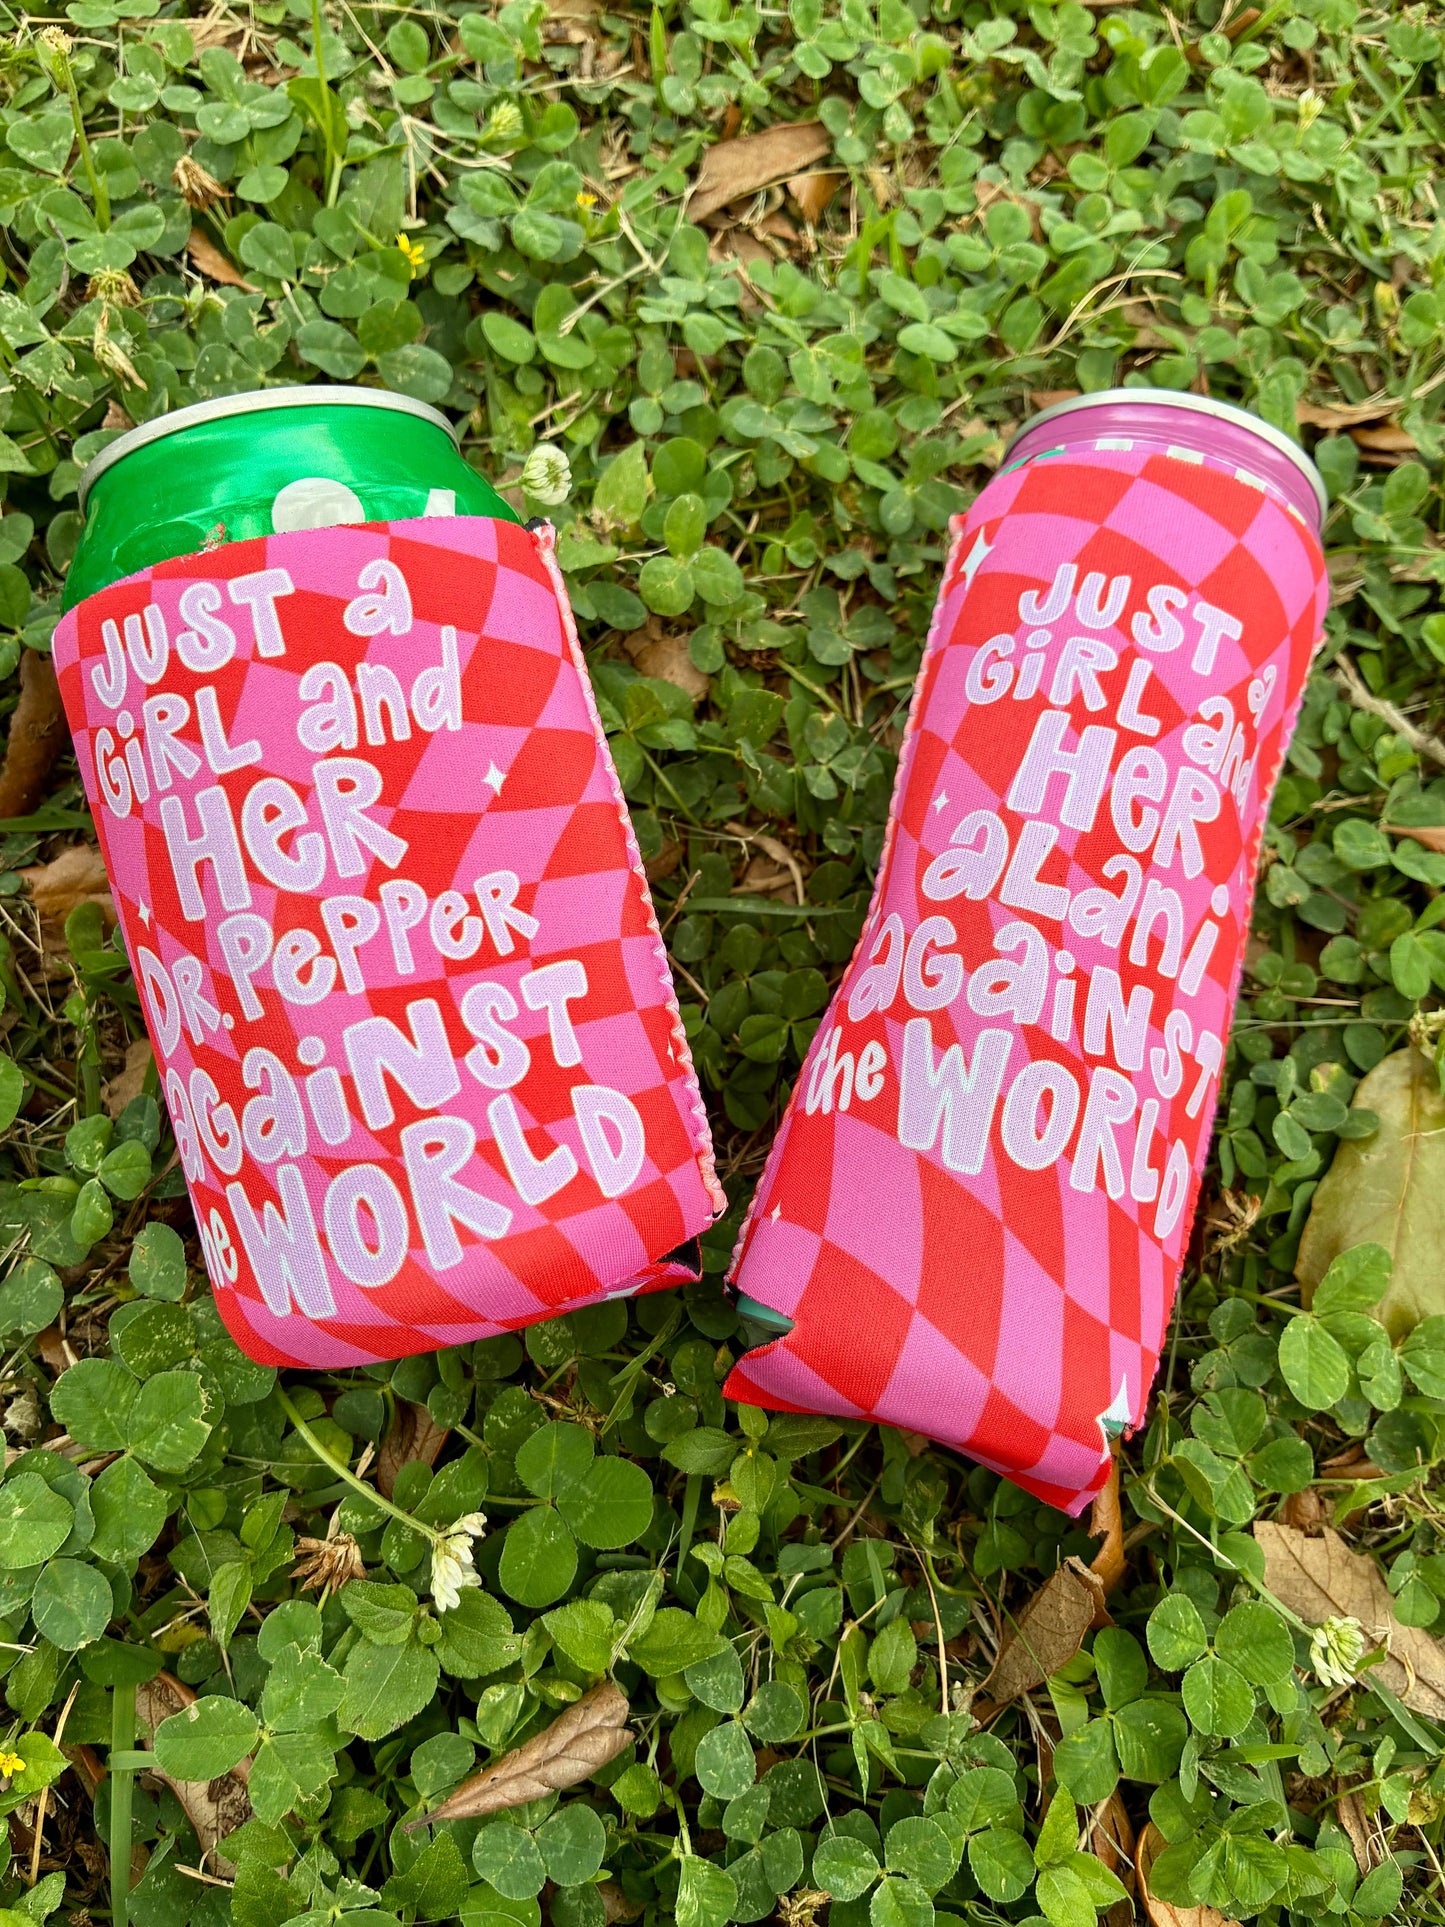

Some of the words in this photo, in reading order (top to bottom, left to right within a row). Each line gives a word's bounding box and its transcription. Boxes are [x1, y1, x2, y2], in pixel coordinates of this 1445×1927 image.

[91, 567, 295, 709] JUST
[344, 559, 413, 637] a
[296, 625, 463, 753] and
[1018, 563, 1242, 676] JUST
[137, 945, 235, 1058] DR.
[805, 1025, 885, 1116] the
[898, 1017, 1189, 1240] WORLD
[192, 1200, 238, 1289] he
[225, 1084, 646, 1320] WORLD
